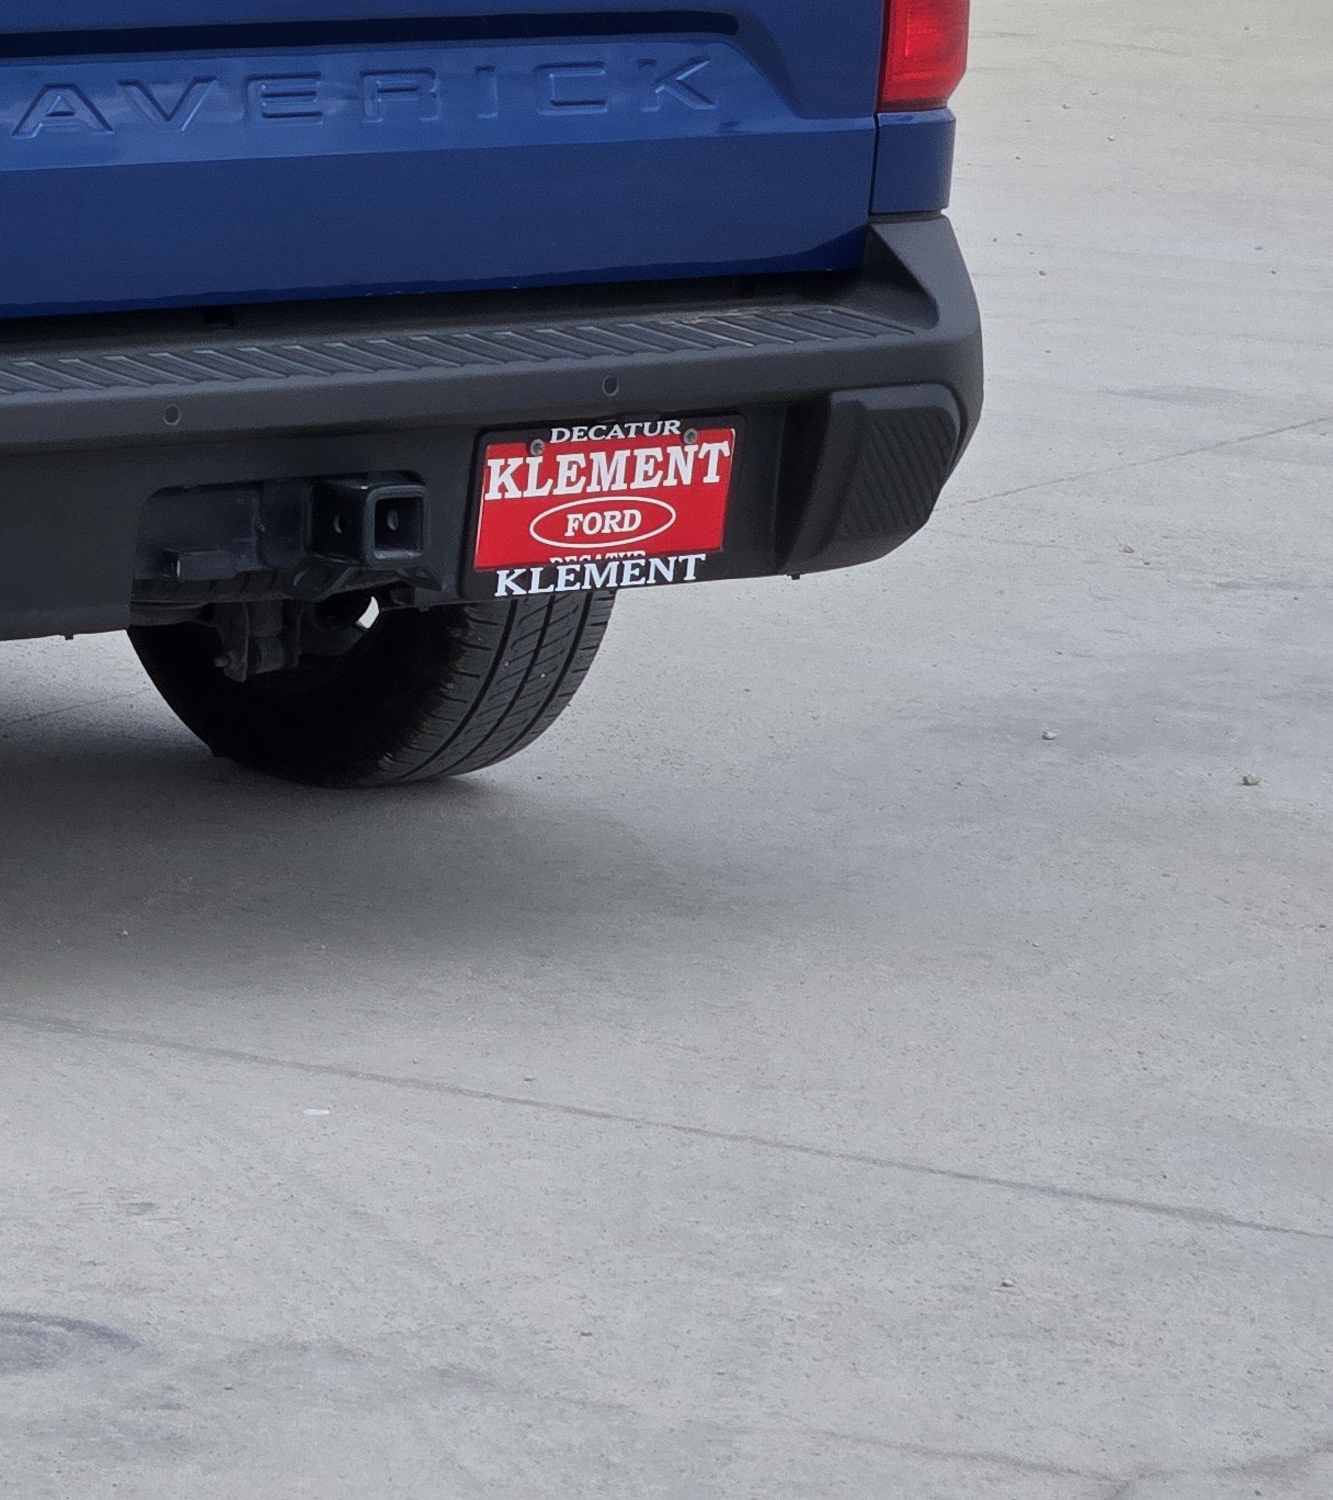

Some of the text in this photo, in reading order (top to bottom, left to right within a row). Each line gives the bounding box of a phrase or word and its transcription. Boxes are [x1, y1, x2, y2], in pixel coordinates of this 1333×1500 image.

[550, 420, 682, 444] DECATUR
[484, 441, 731, 500] KLEMENT
[564, 509, 642, 537] FORD
[494, 553, 706, 597] KLEMENT
